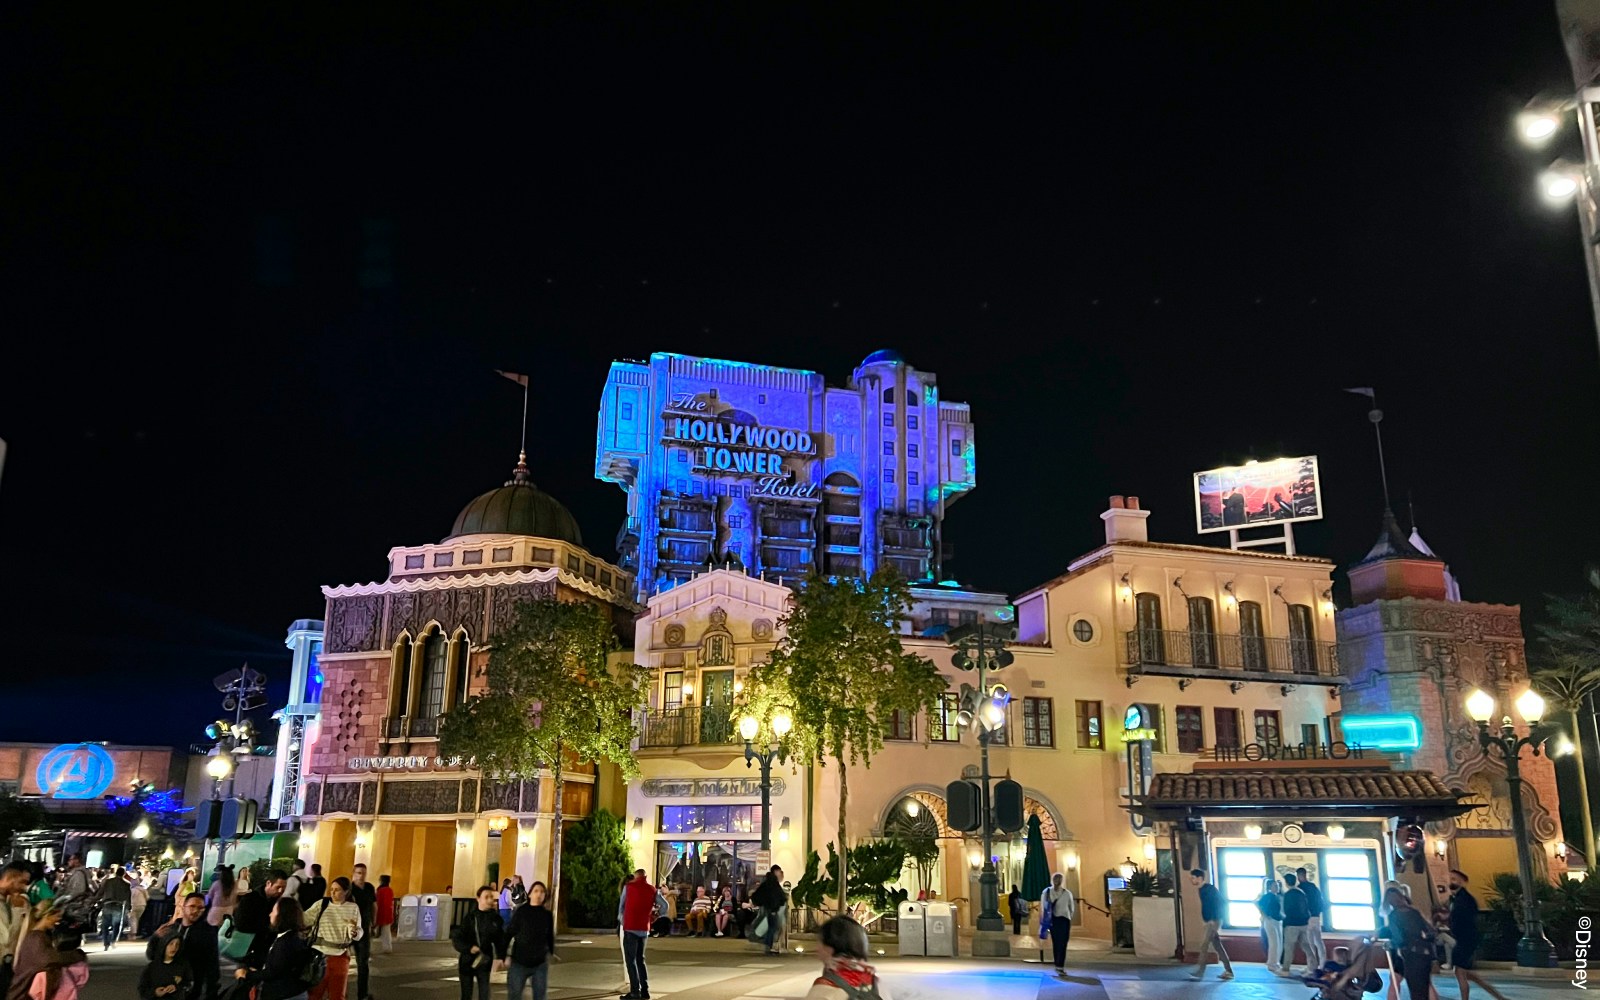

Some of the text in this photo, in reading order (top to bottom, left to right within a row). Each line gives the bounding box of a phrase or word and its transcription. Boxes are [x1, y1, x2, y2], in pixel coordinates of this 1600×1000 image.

[669, 392, 707, 412] The
[675, 418, 812, 452] HOLLYWOOD
[704, 446, 783, 476] TOWER
[755, 476, 818, 499] Hotel
